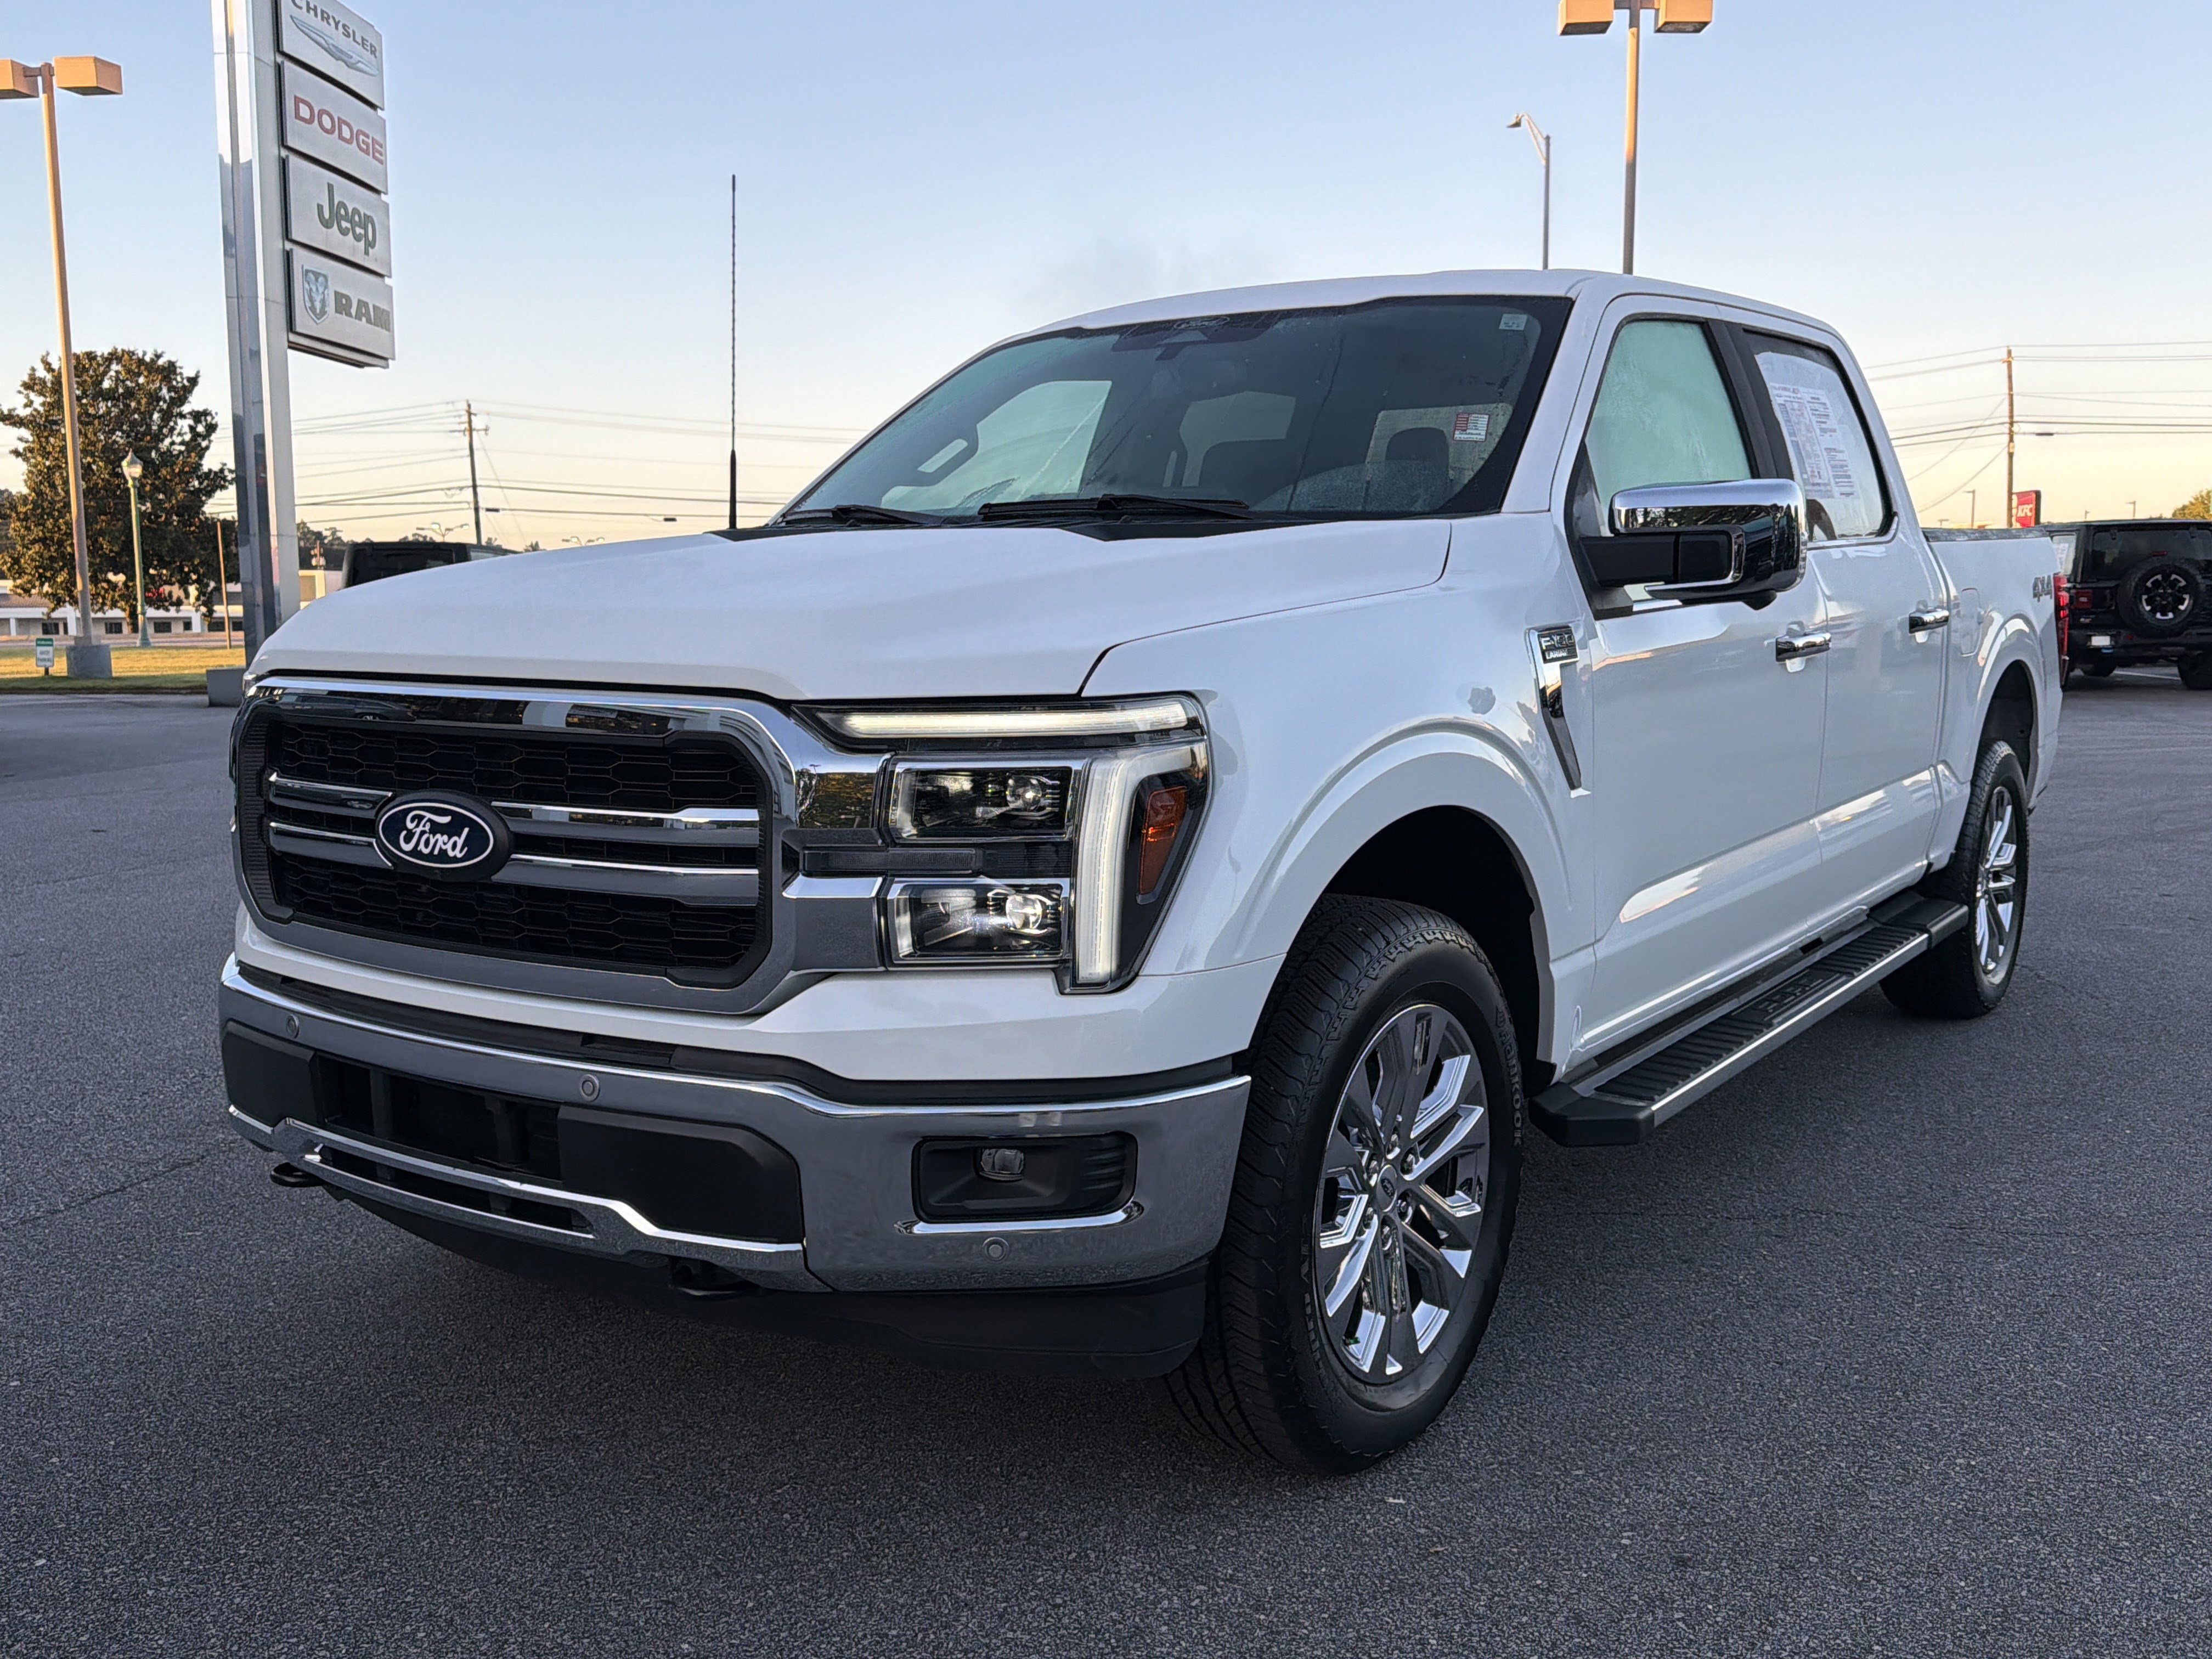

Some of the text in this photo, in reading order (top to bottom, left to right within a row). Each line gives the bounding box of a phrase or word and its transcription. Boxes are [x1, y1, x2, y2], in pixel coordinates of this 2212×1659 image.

[291, 0, 377, 59] CHRYSLER
[294, 94, 384, 165] DODGE
[317, 182, 377, 257] Jeep
[334, 290, 391, 332] RAM
[2017, 504, 2033, 517] KFC
[399, 810, 470, 859] Ford
